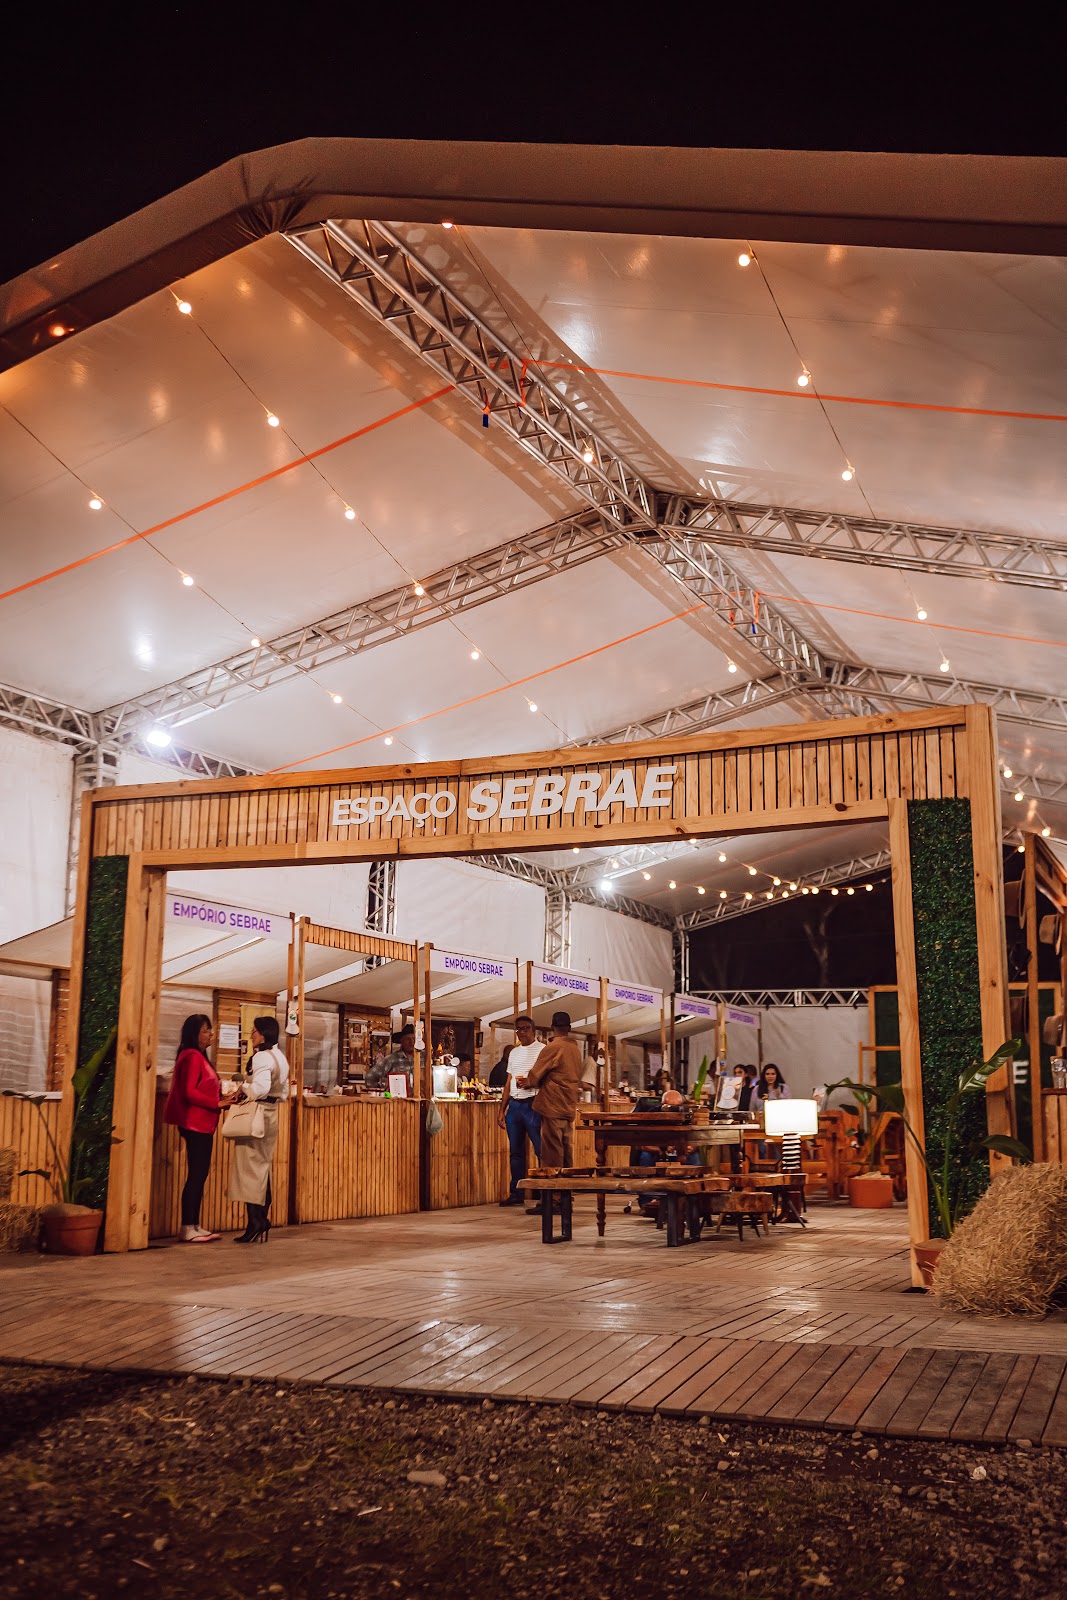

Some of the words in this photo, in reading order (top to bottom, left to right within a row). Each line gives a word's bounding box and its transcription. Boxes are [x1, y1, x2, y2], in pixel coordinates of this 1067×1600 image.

[332, 790, 457, 829] ESPAÇO
[466, 765, 678, 821] SEBRAE
[173, 902, 226, 924] EMPÓRIO
[229, 913, 271, 932] SEBRAE
[445, 956, 477, 972] EMPÓRIO
[478, 962, 504, 977] SEBRAE
[542, 973, 568, 987] EMPÓRIO
[568, 979, 589, 992] SEBRAE
[636, 992, 654, 1004] SEBRAE
